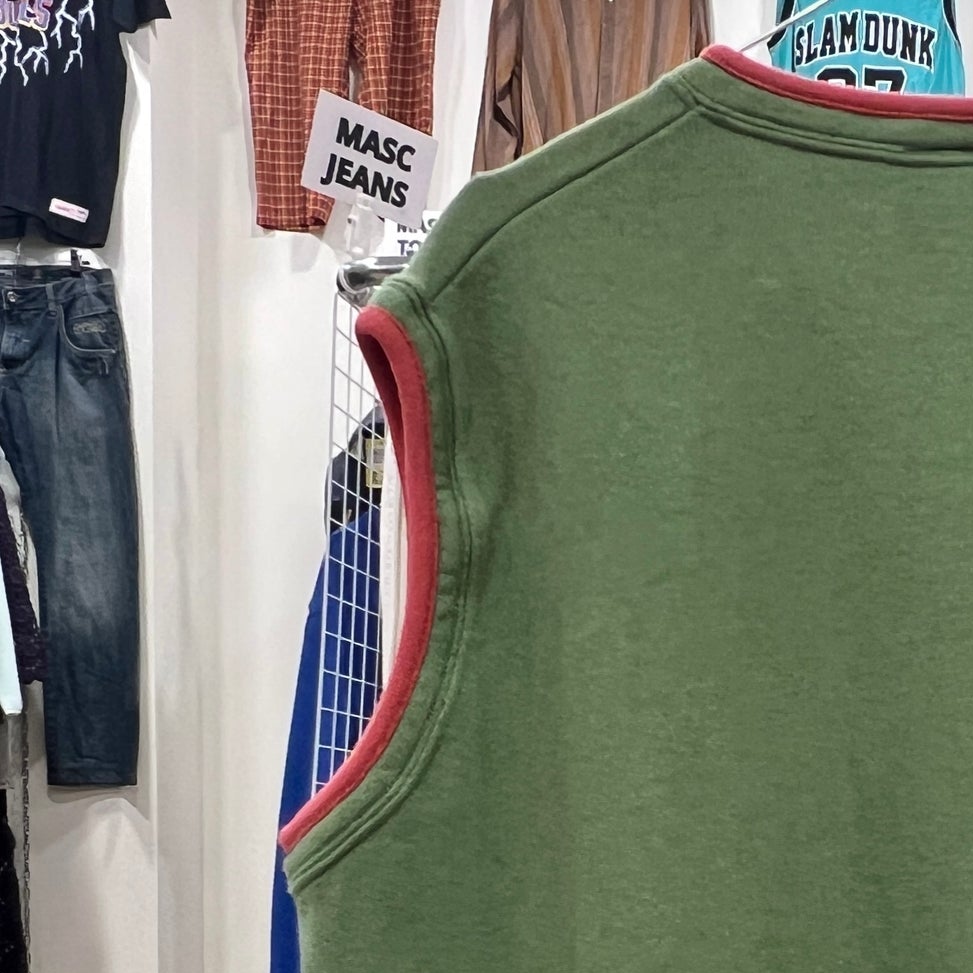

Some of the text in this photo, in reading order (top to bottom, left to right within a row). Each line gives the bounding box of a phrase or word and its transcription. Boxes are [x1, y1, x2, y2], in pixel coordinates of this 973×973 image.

[794, 10, 938, 72] SLAM DUNK
[336, 117, 416, 172] MASC
[320, 153, 409, 208] JEANS
